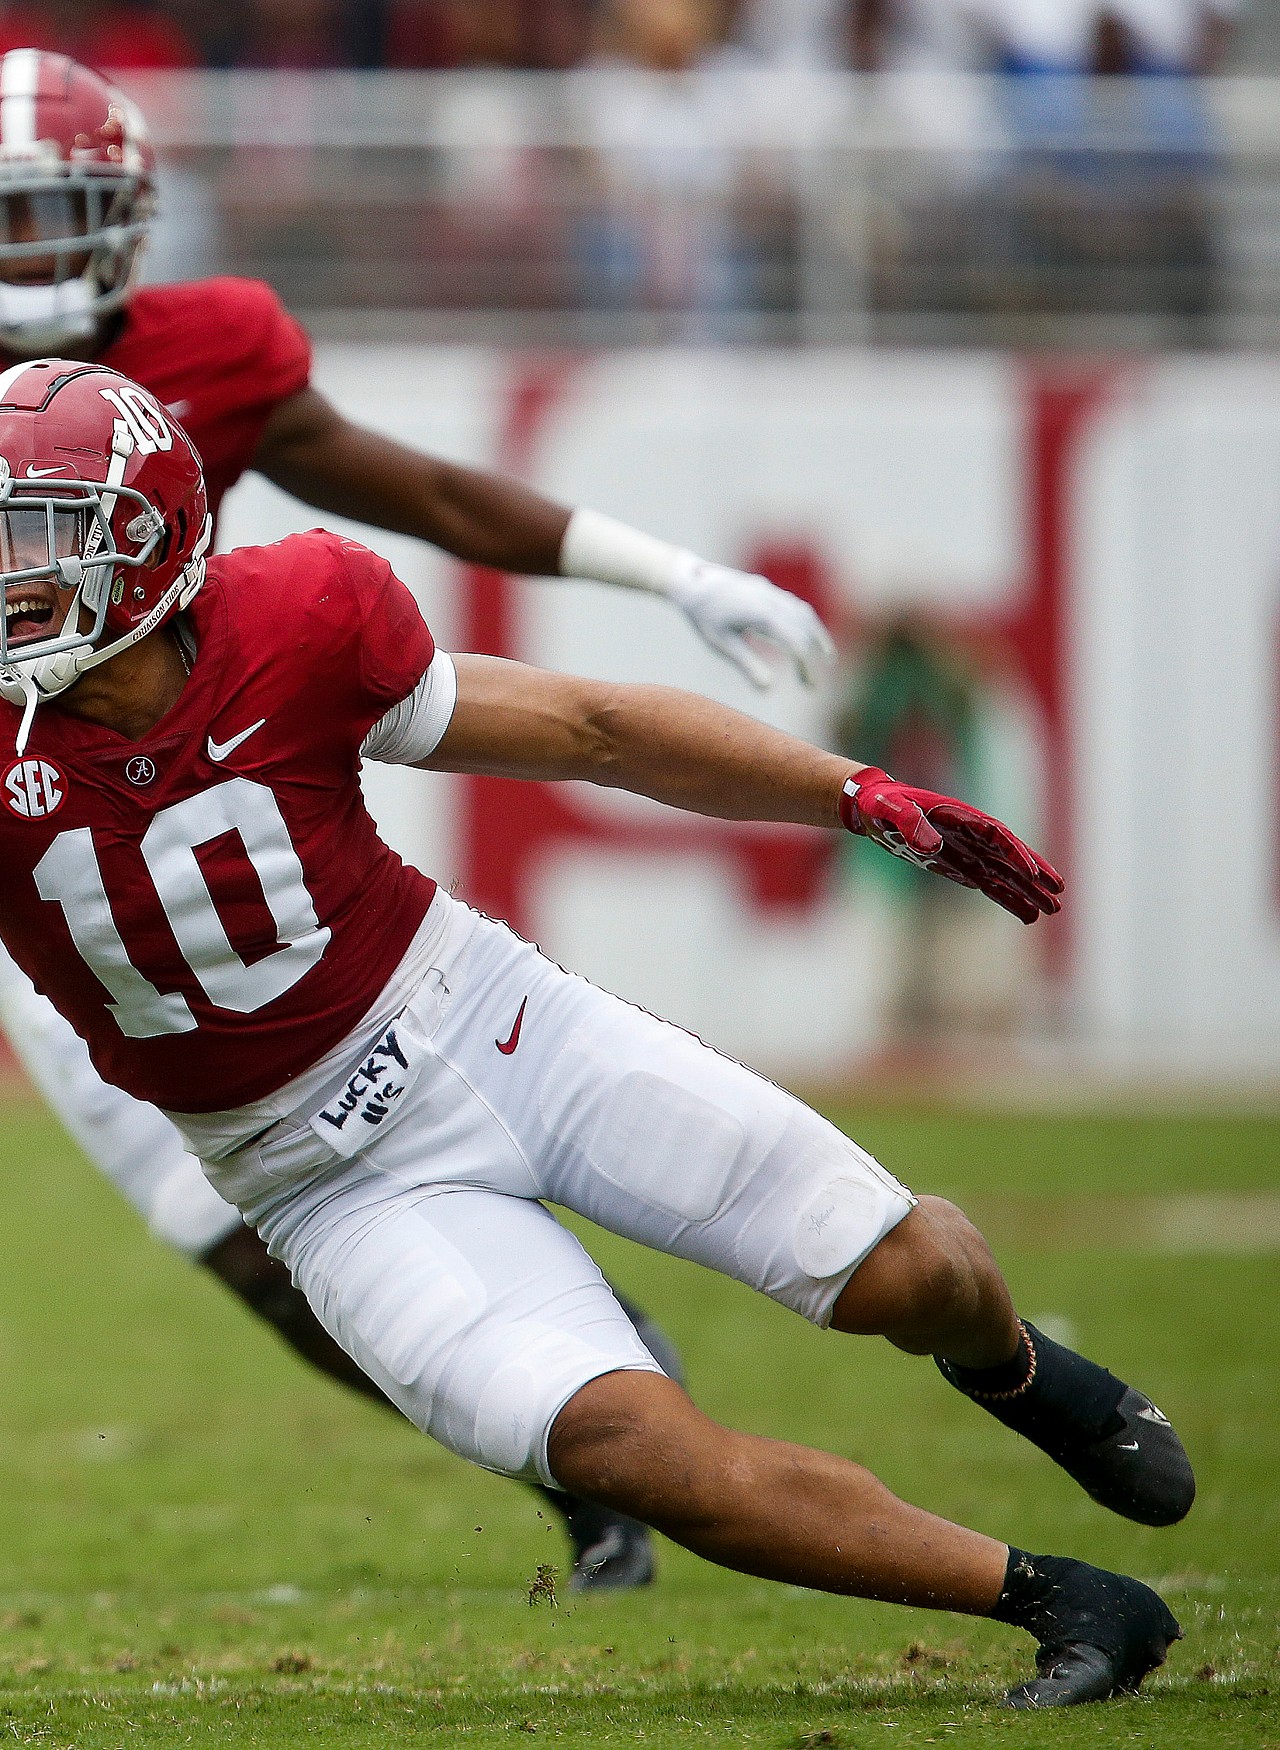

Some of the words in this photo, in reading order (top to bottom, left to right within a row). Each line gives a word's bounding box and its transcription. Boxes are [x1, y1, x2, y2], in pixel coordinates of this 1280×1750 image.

[98, 386, 173, 456] 10
[5, 760, 63, 817] SEC
[32, 777, 332, 1038] 10
[318, 1030, 409, 1130] LUCKY
